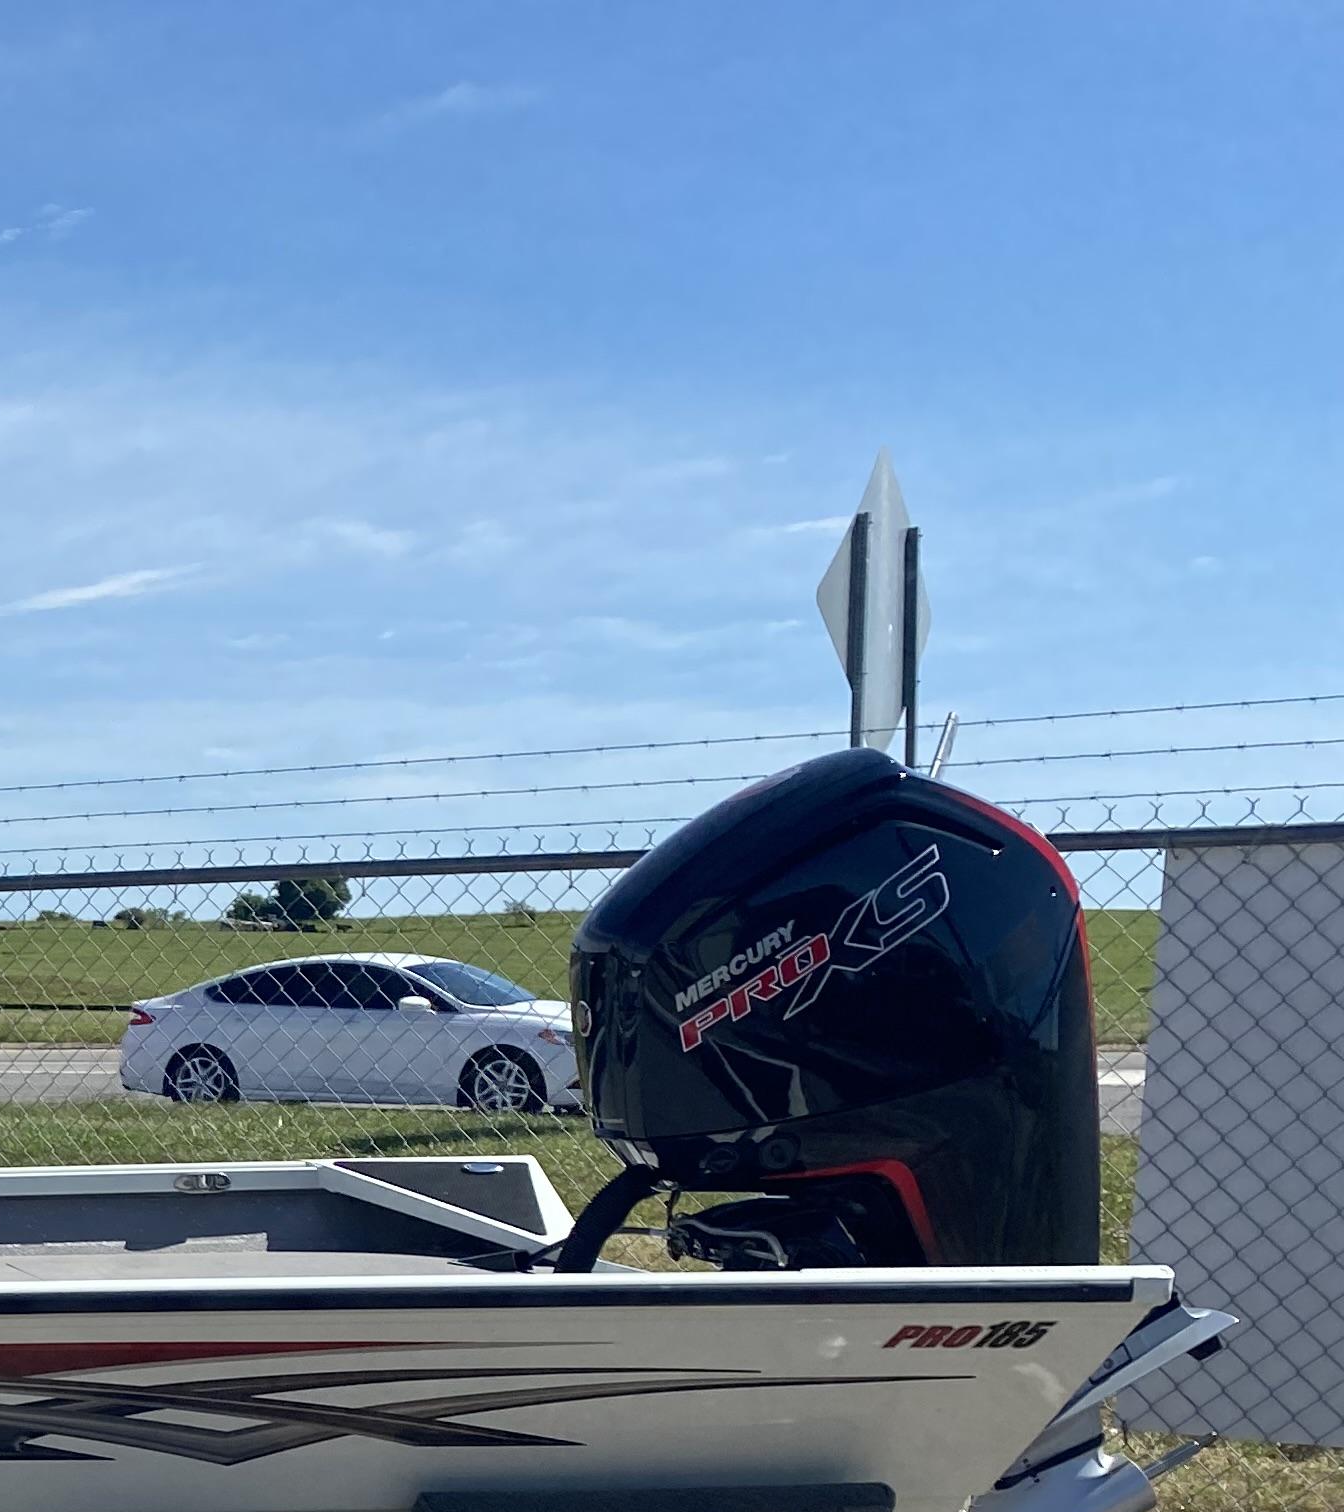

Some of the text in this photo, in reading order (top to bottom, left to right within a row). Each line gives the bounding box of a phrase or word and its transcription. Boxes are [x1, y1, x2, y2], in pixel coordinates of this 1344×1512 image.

[674, 919, 796, 1013] MERCURY
[679, 843, 950, 1053] PRO XS
